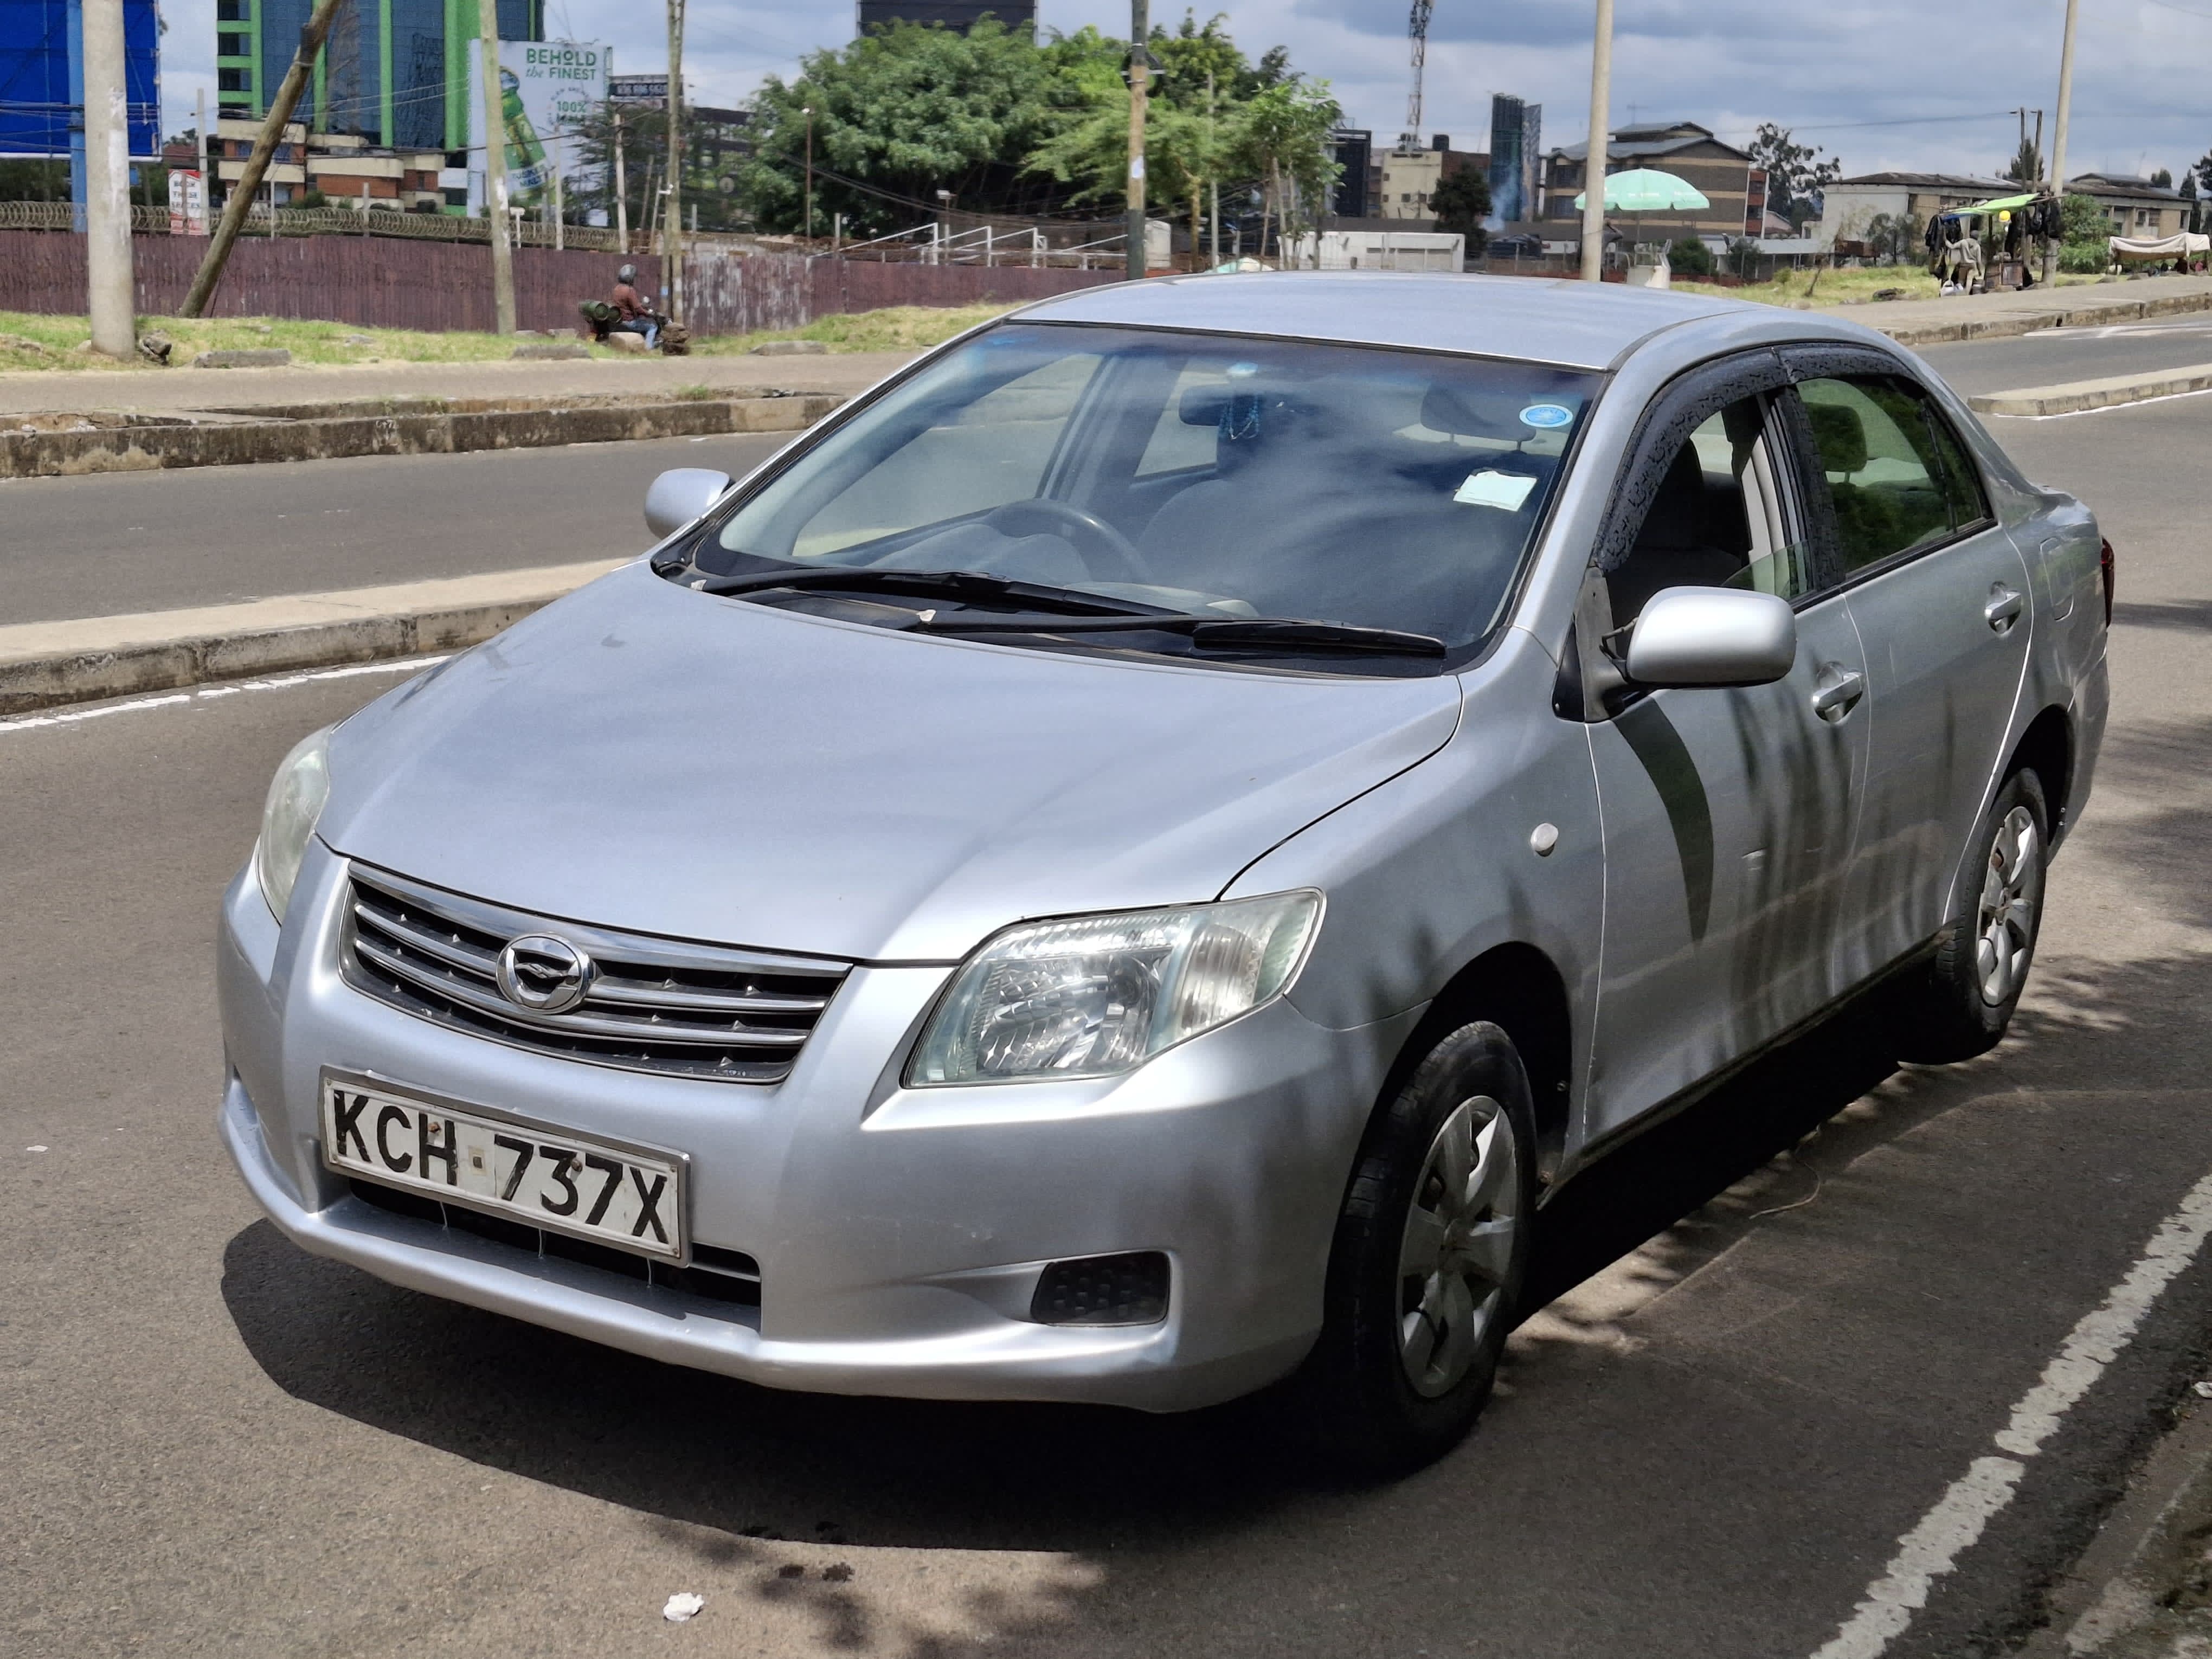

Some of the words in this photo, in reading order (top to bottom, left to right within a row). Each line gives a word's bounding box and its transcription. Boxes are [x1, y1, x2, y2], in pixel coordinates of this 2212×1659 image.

[526, 48, 596, 66] BEHOLD
[526, 66, 543, 78] the
[549, 67, 596, 80] FINEST
[557, 101, 586, 113] 100%
[333, 1089, 459, 1187] KCH
[493, 1133, 668, 1245] 737X
